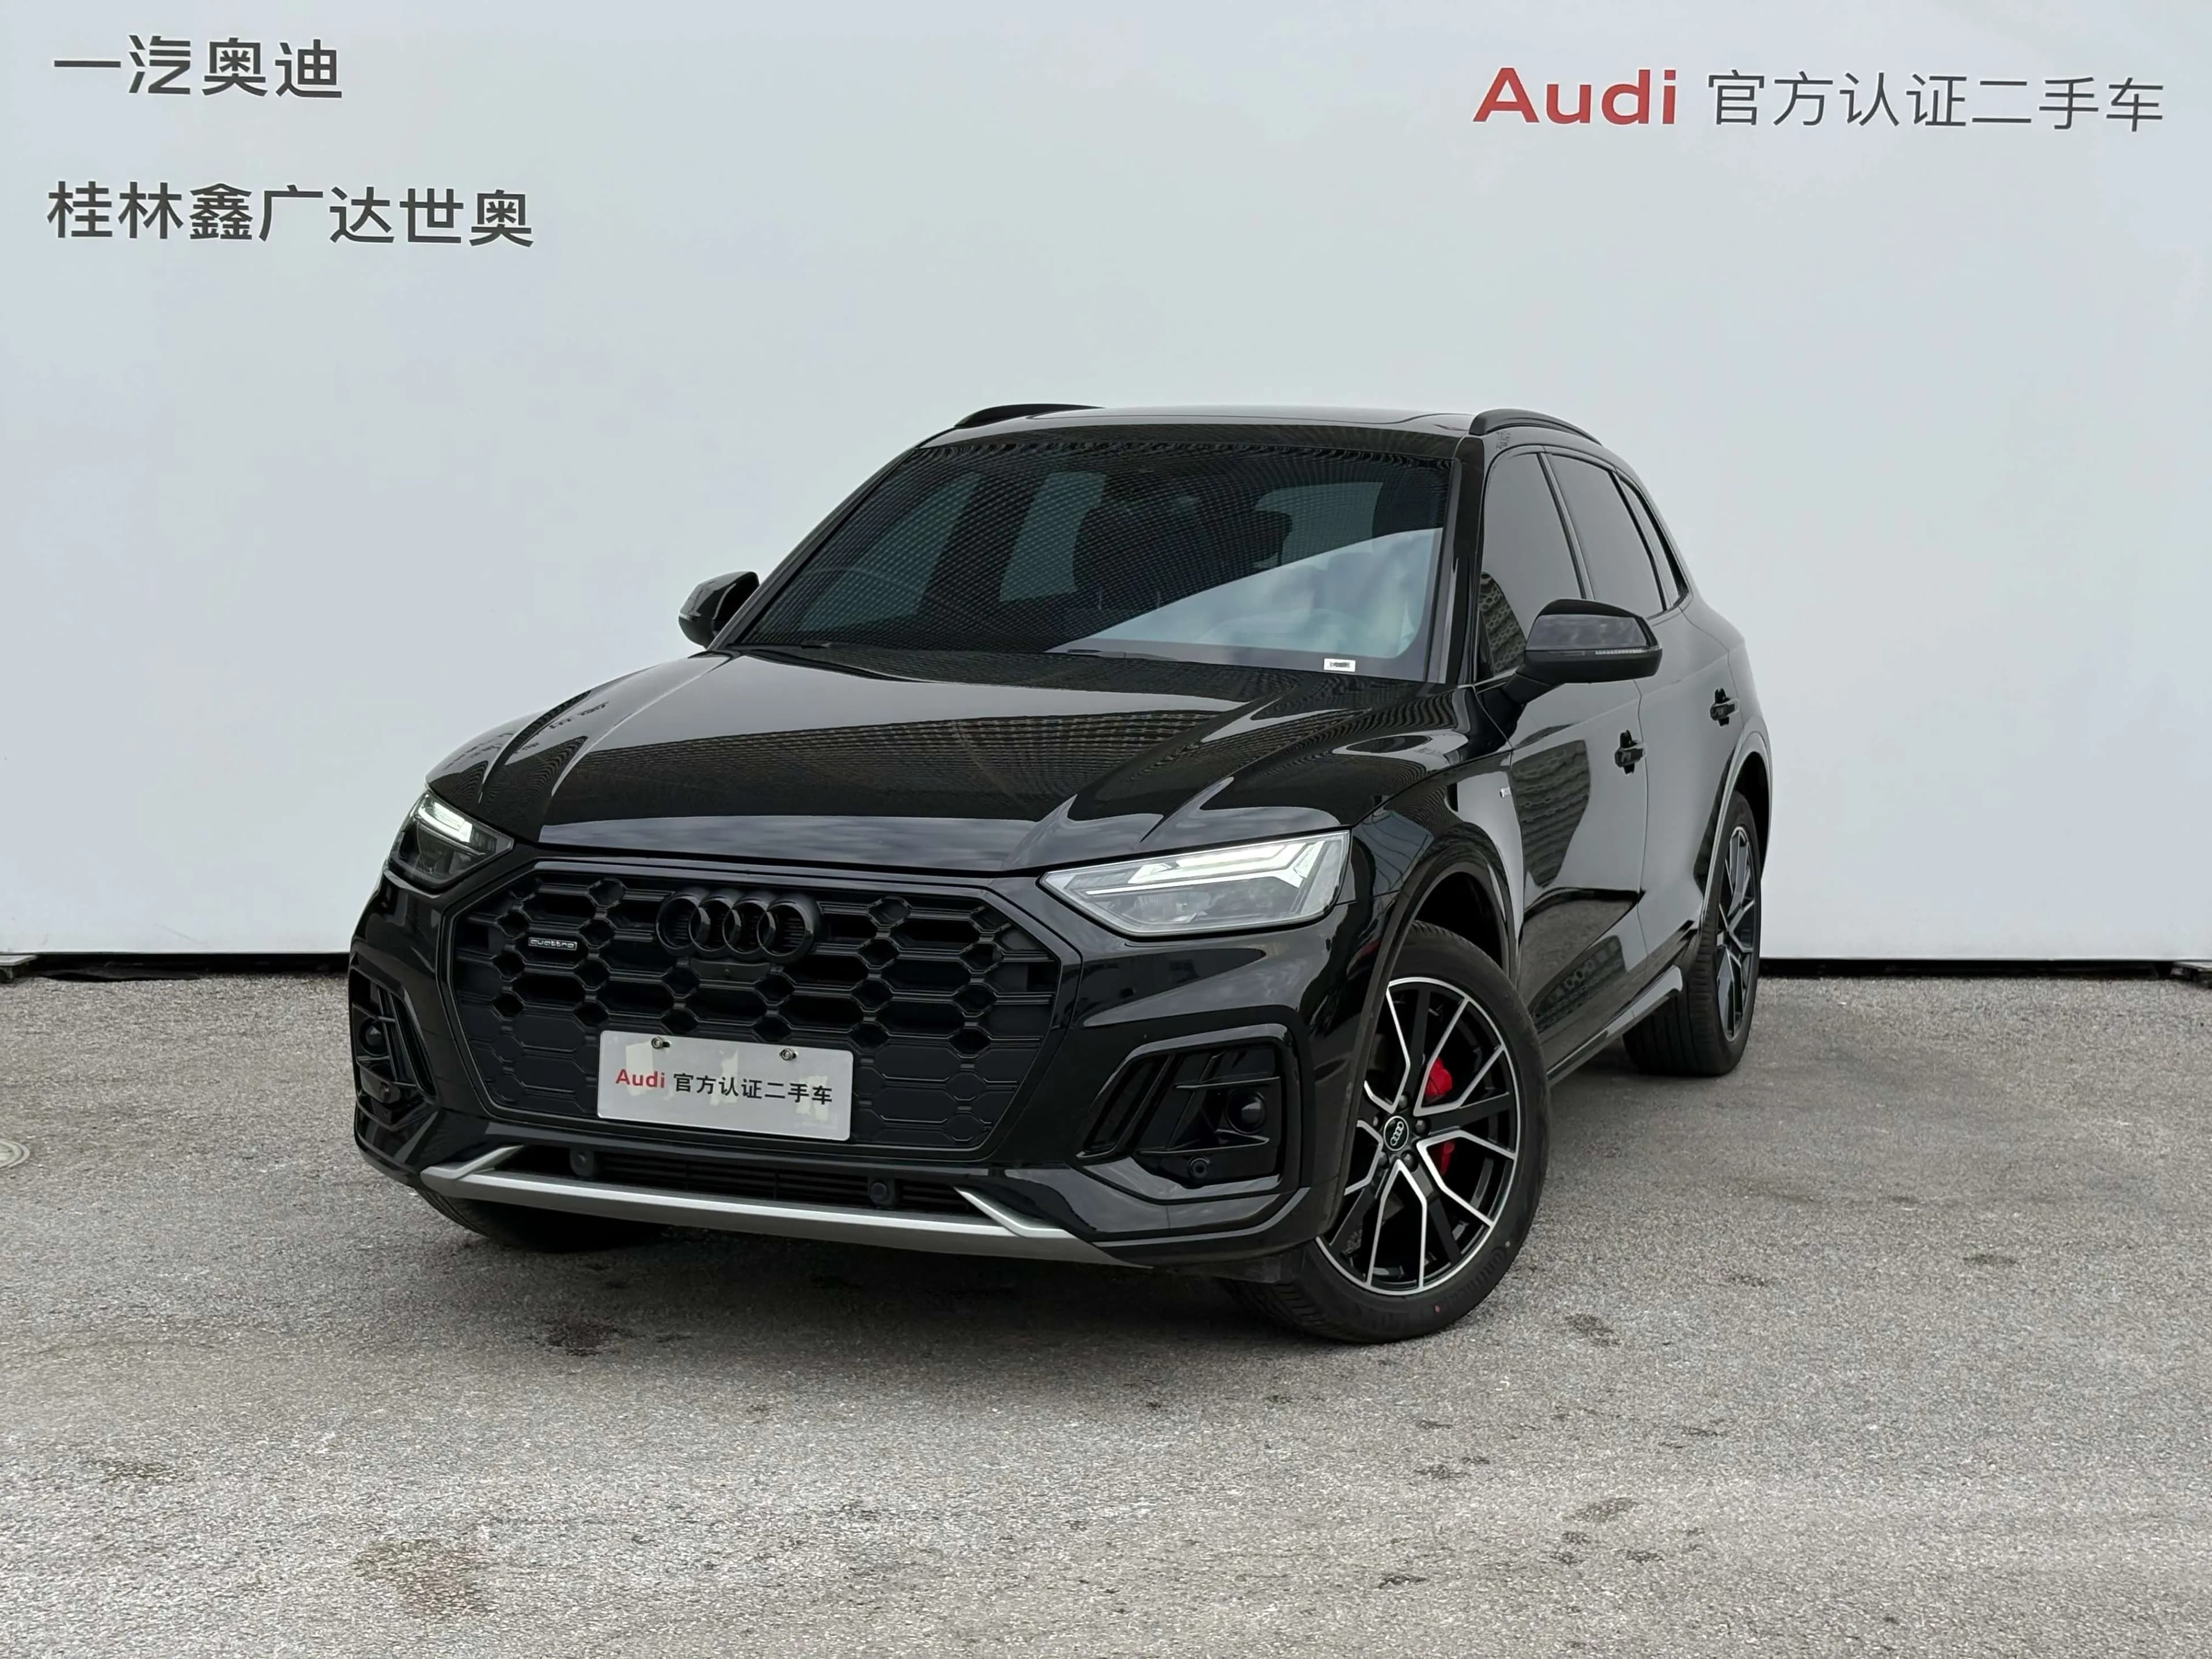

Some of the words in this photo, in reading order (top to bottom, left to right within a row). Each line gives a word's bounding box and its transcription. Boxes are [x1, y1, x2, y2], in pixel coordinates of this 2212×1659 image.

[54, 35, 342, 99] 一汽奥迪
[1474, 67, 1676, 125] Audi
[1707, 69, 2164, 132] 官方认证二手车
[47, 181, 533, 247] 桂林鑫广达世奥
[530, 939, 574, 948] quattro
[616, 1069, 665, 1088] Audi
[673, 1073, 833, 1105] 官方认证二手车
